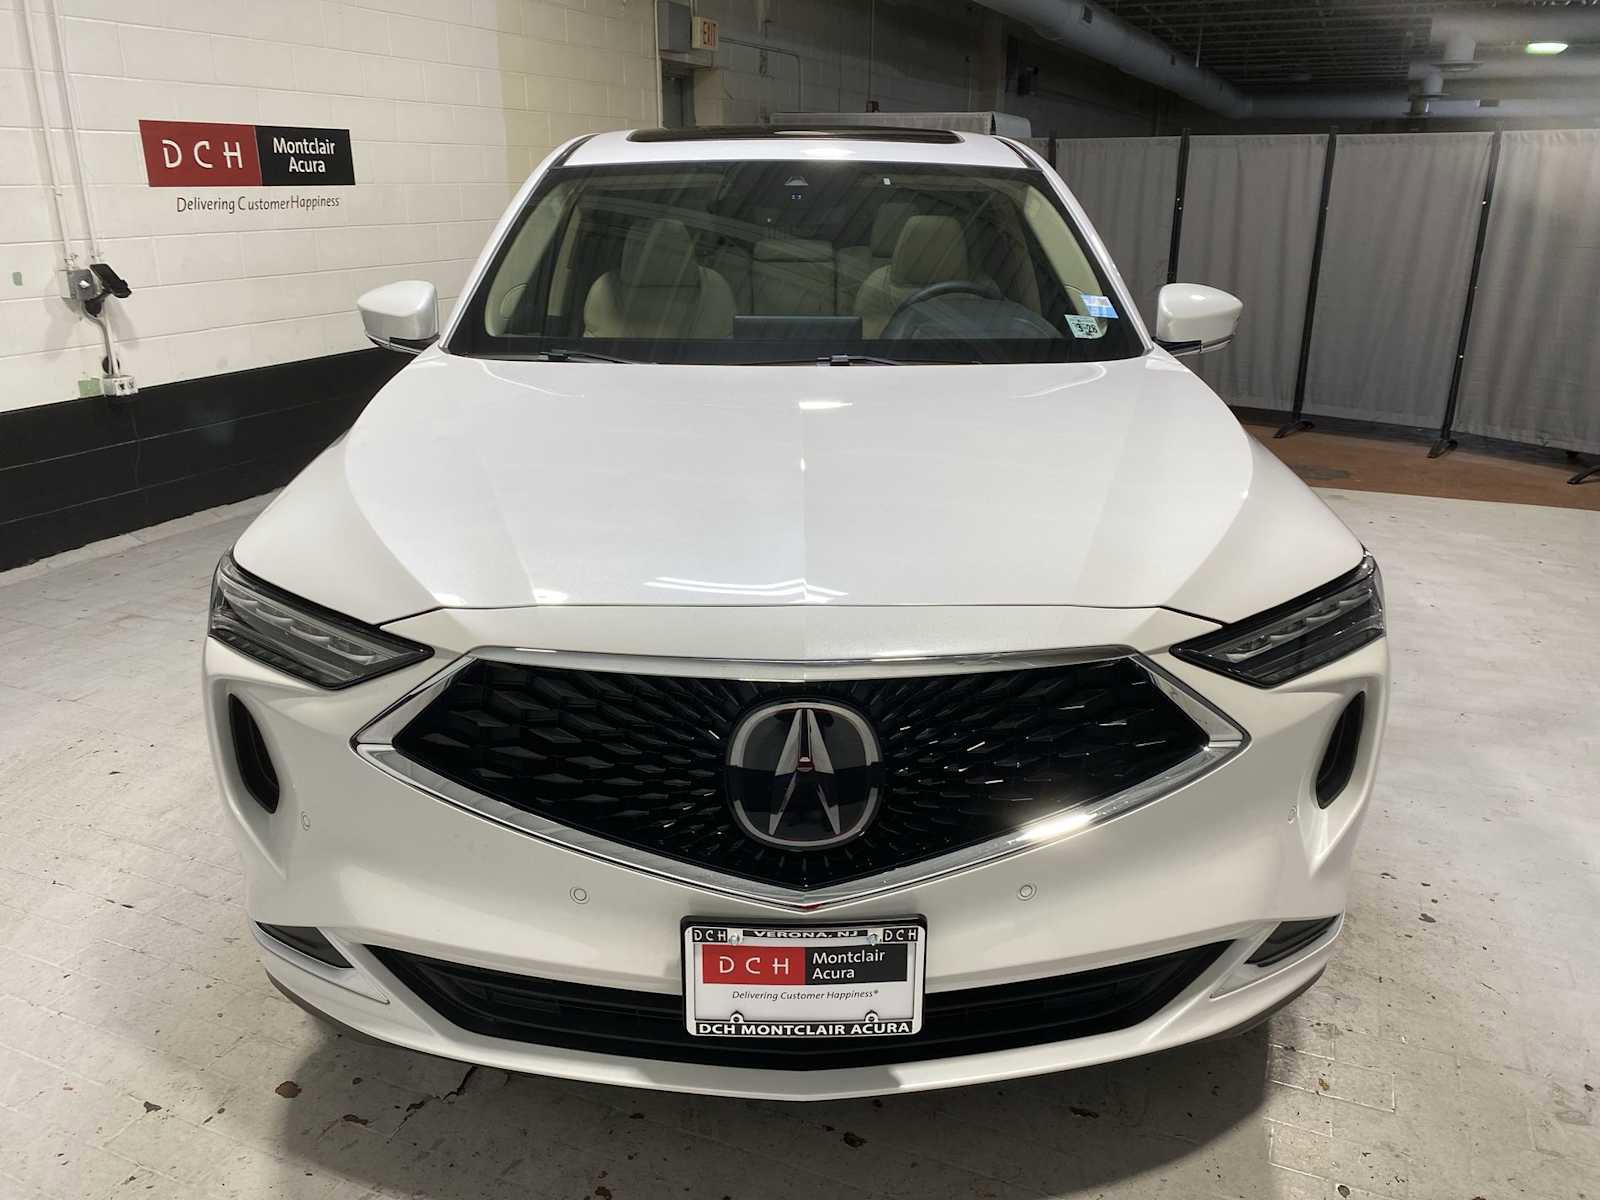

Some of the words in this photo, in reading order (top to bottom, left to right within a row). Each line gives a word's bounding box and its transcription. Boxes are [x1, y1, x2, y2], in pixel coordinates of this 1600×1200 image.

[703, 21, 717, 47] EXIT
[162, 139, 243, 169] DCH
[273, 137, 335, 155] Montclair
[288, 157, 326, 173] Acura
[176, 196, 235, 214] Delivering
[693, 929, 727, 942] DCH
[884, 928, 917, 941] DCH
[719, 955, 789, 975] DCH
[812, 949, 885, 965] Montclair
[812, 967, 855, 980] Acura
[732, 991, 778, 1002] Delivering
[780, 990, 825, 1000] Customer
[699, 1023, 736, 1035] DCH
[741, 1023, 846, 1036] MONTCLAIR
[850, 1022, 910, 1034] ACURA
